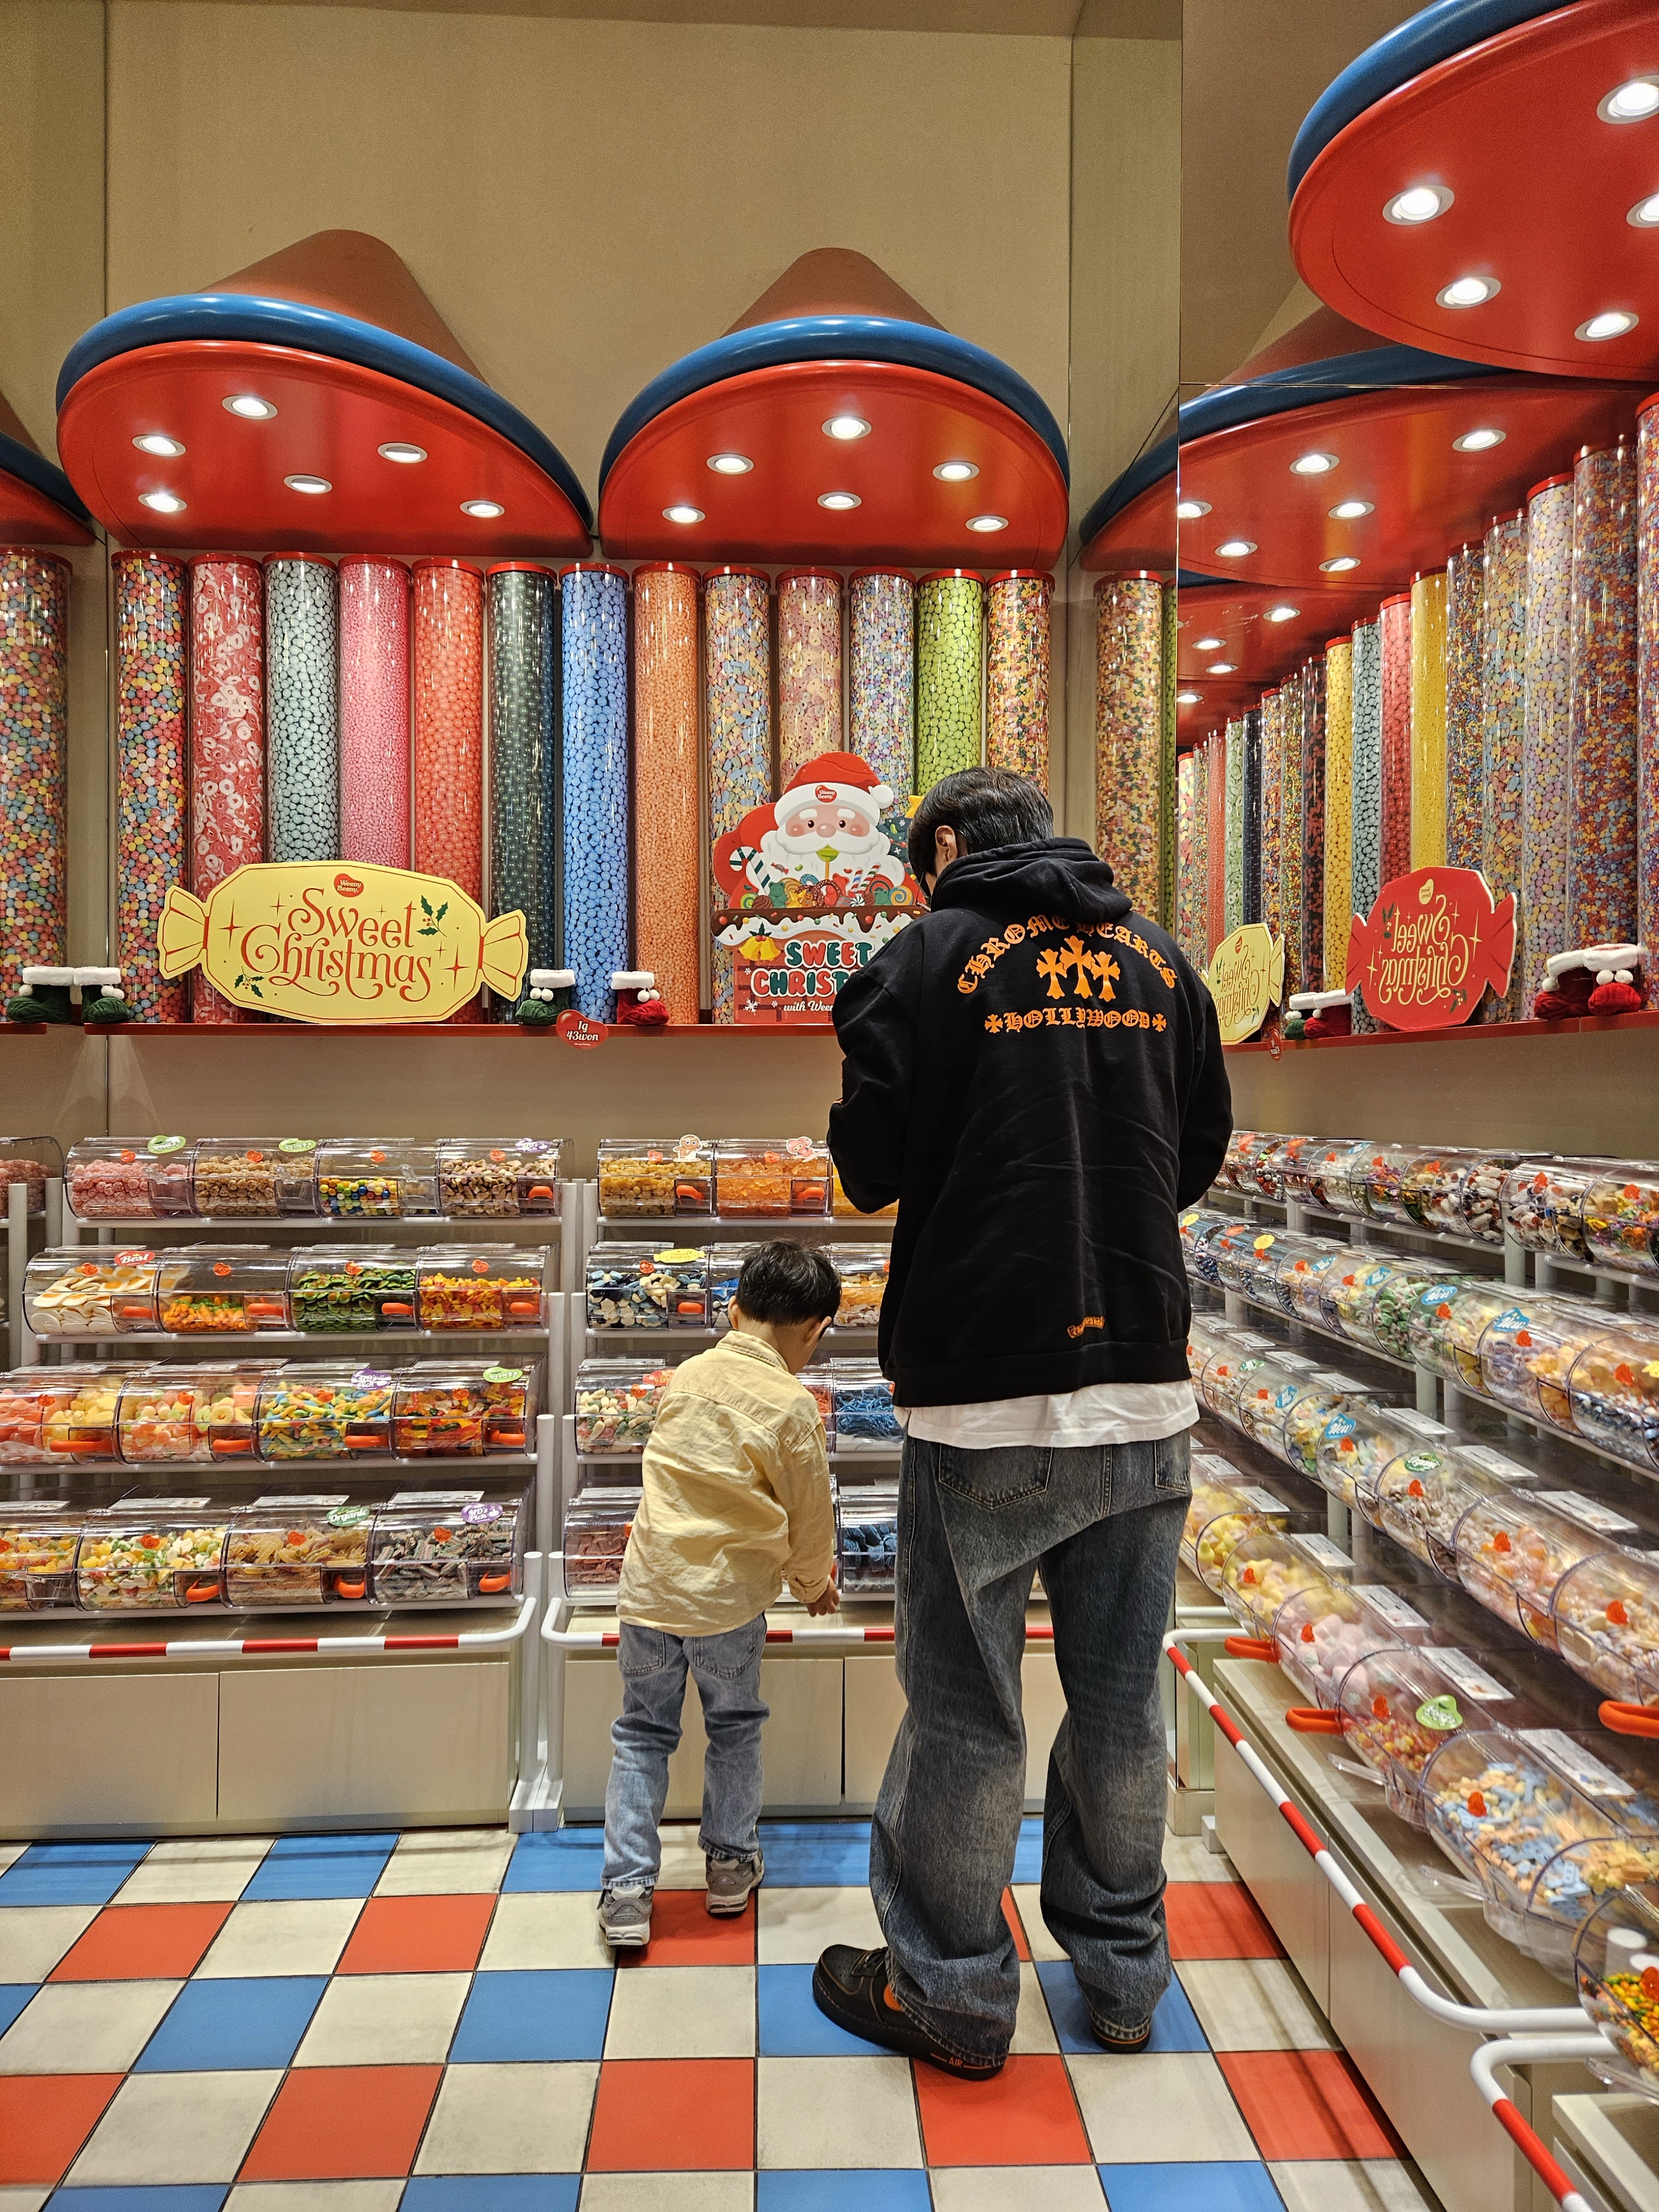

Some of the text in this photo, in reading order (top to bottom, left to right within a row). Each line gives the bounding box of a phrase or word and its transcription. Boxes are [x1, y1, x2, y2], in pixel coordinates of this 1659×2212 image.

[340, 880, 361, 888] Weeny
[288, 888, 416, 948] Sweet
[785, 941, 874, 967] SWEET
[241, 922, 431, 1002] Christmas
[753, 970, 855, 995] CHRIST
[784, 1001, 806, 1012] with
[578, 1020, 589, 1033] 1g
[1003, 1007, 1150, 1033] HOLLYWOOD
[566, 1030, 599, 1041] 43won
[119, 1253, 149, 1264] Best
[1328, 1422, 1353, 1435] New
[328, 1509, 367, 1522] Organic
[468, 1507, 488, 1516] MD's
[468, 1514, 487, 1522] Pick
[948, 2057, 963, 2068] AIR
